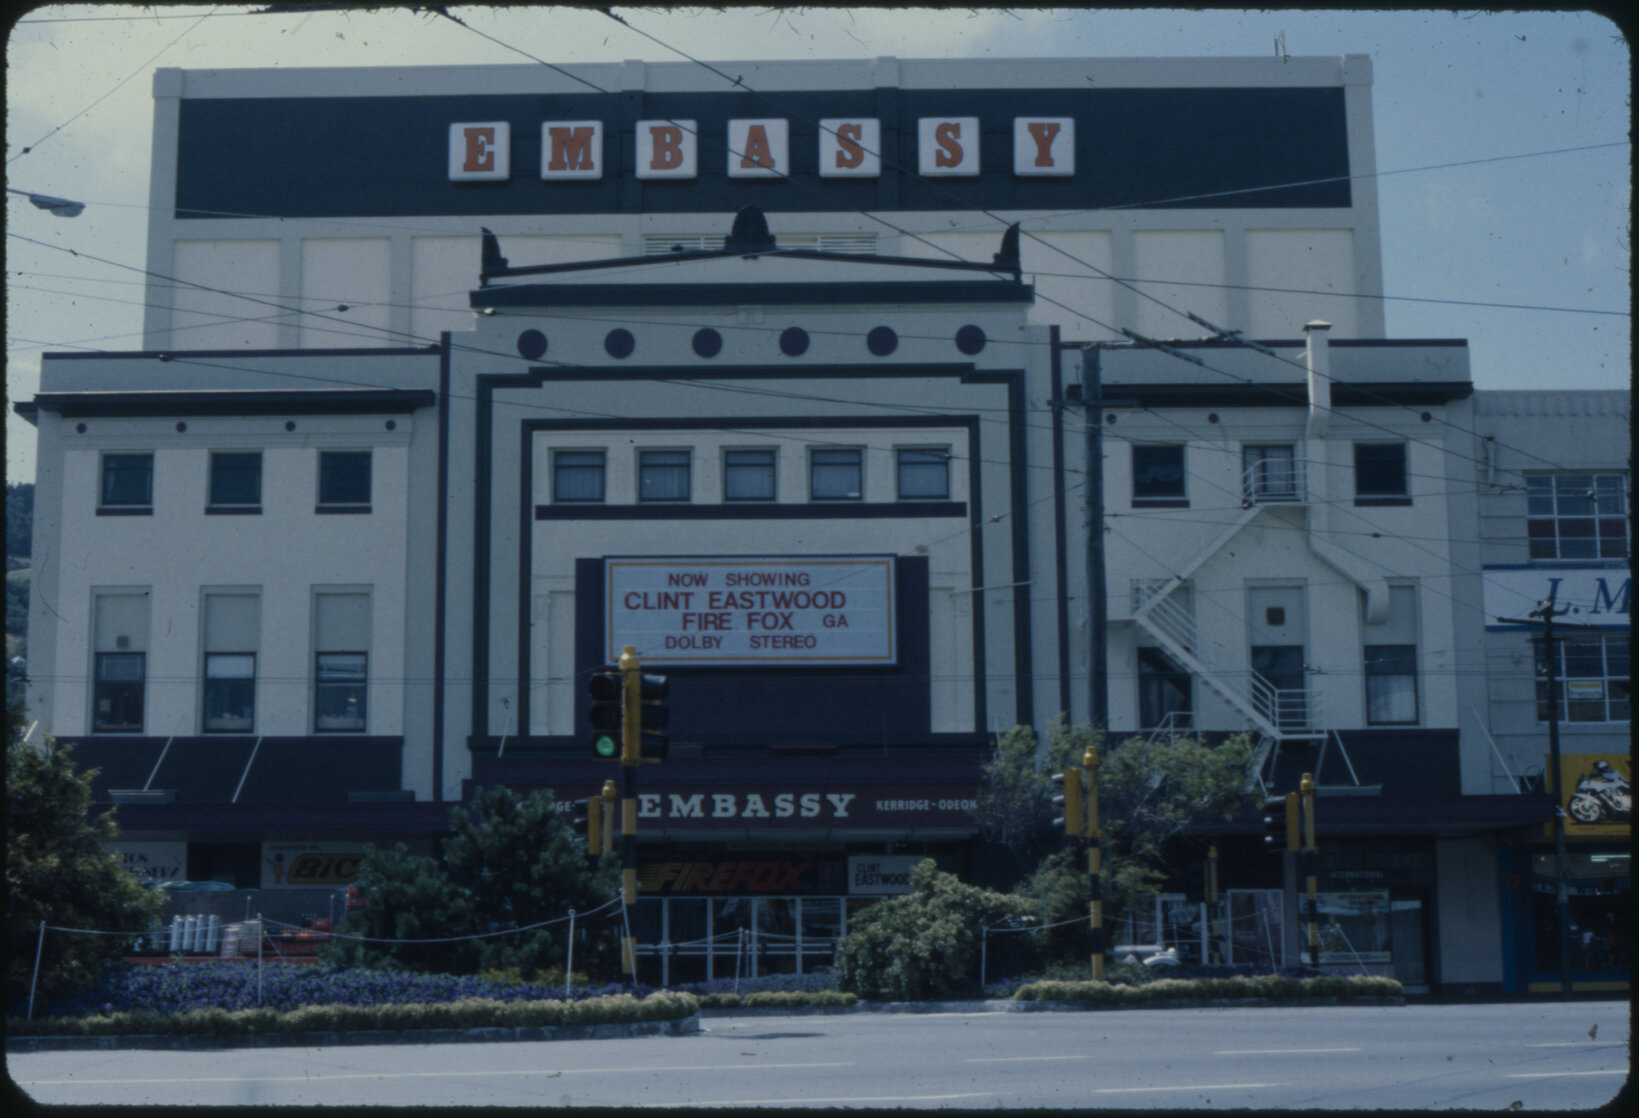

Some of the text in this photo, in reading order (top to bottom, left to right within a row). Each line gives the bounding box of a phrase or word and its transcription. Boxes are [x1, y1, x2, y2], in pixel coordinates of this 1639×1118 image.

[462, 122, 1061, 172] EMBASSY
[668, 572, 811, 587] NOW SHOWING
[624, 591, 847, 610] CLINT EASTWOOD
[682, 611, 848, 631] FIRE FOX GA
[665, 634, 817, 649] DOLBY STEREO
[637, 793, 856, 818] EMBASSY
[294, 857, 363, 879] BIC
[640, 861, 811, 892] FIREFOX
[856, 863, 881, 873] CLINT
